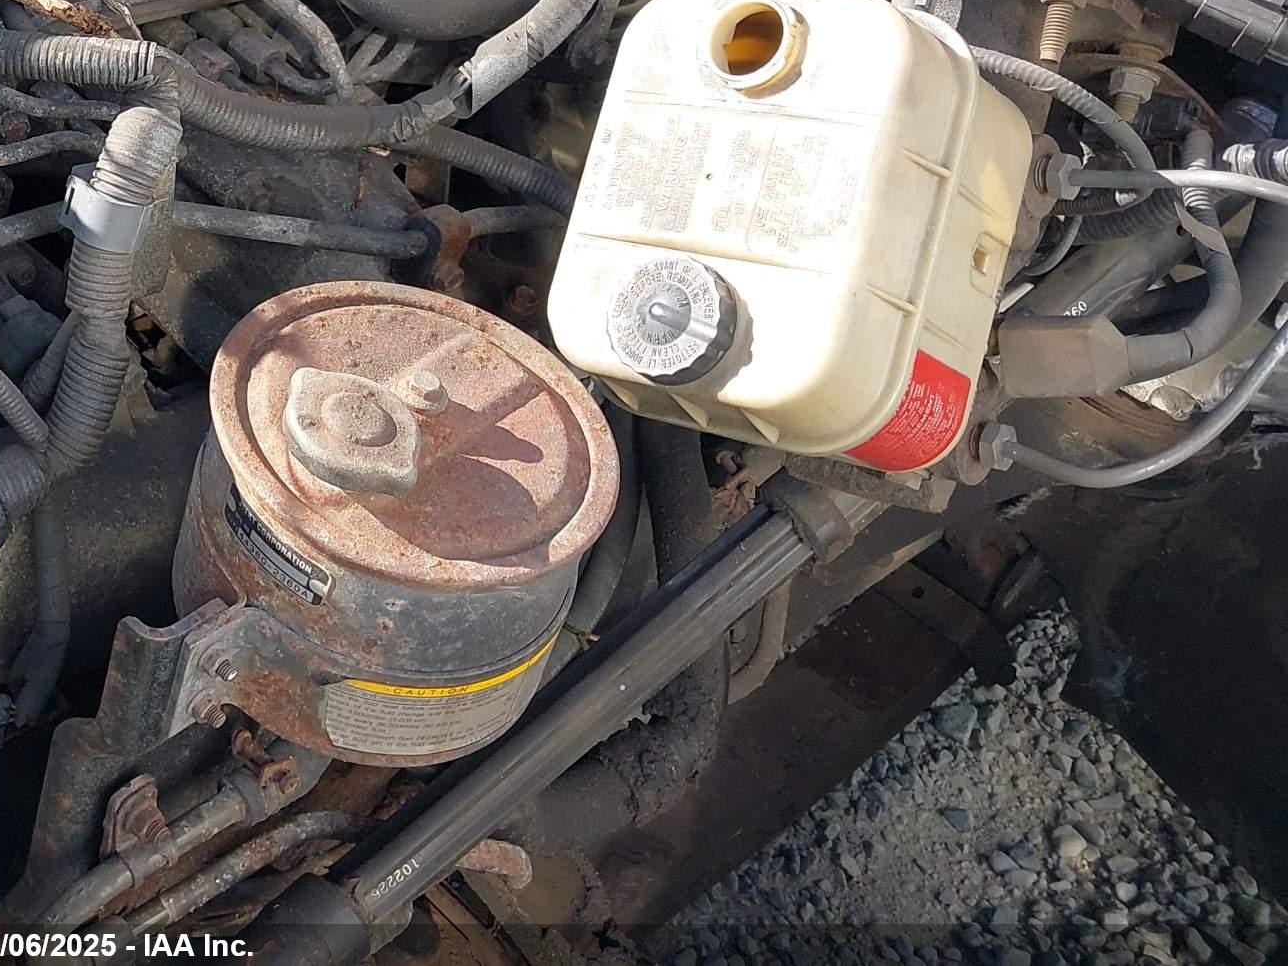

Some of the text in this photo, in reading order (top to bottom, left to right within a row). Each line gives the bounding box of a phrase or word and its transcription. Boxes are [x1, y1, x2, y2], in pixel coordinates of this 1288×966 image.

[257, 524, 312, 573] CORPORATION
[393, 684, 470, 695] CAUTION
[370, 857, 420, 899] 102226
